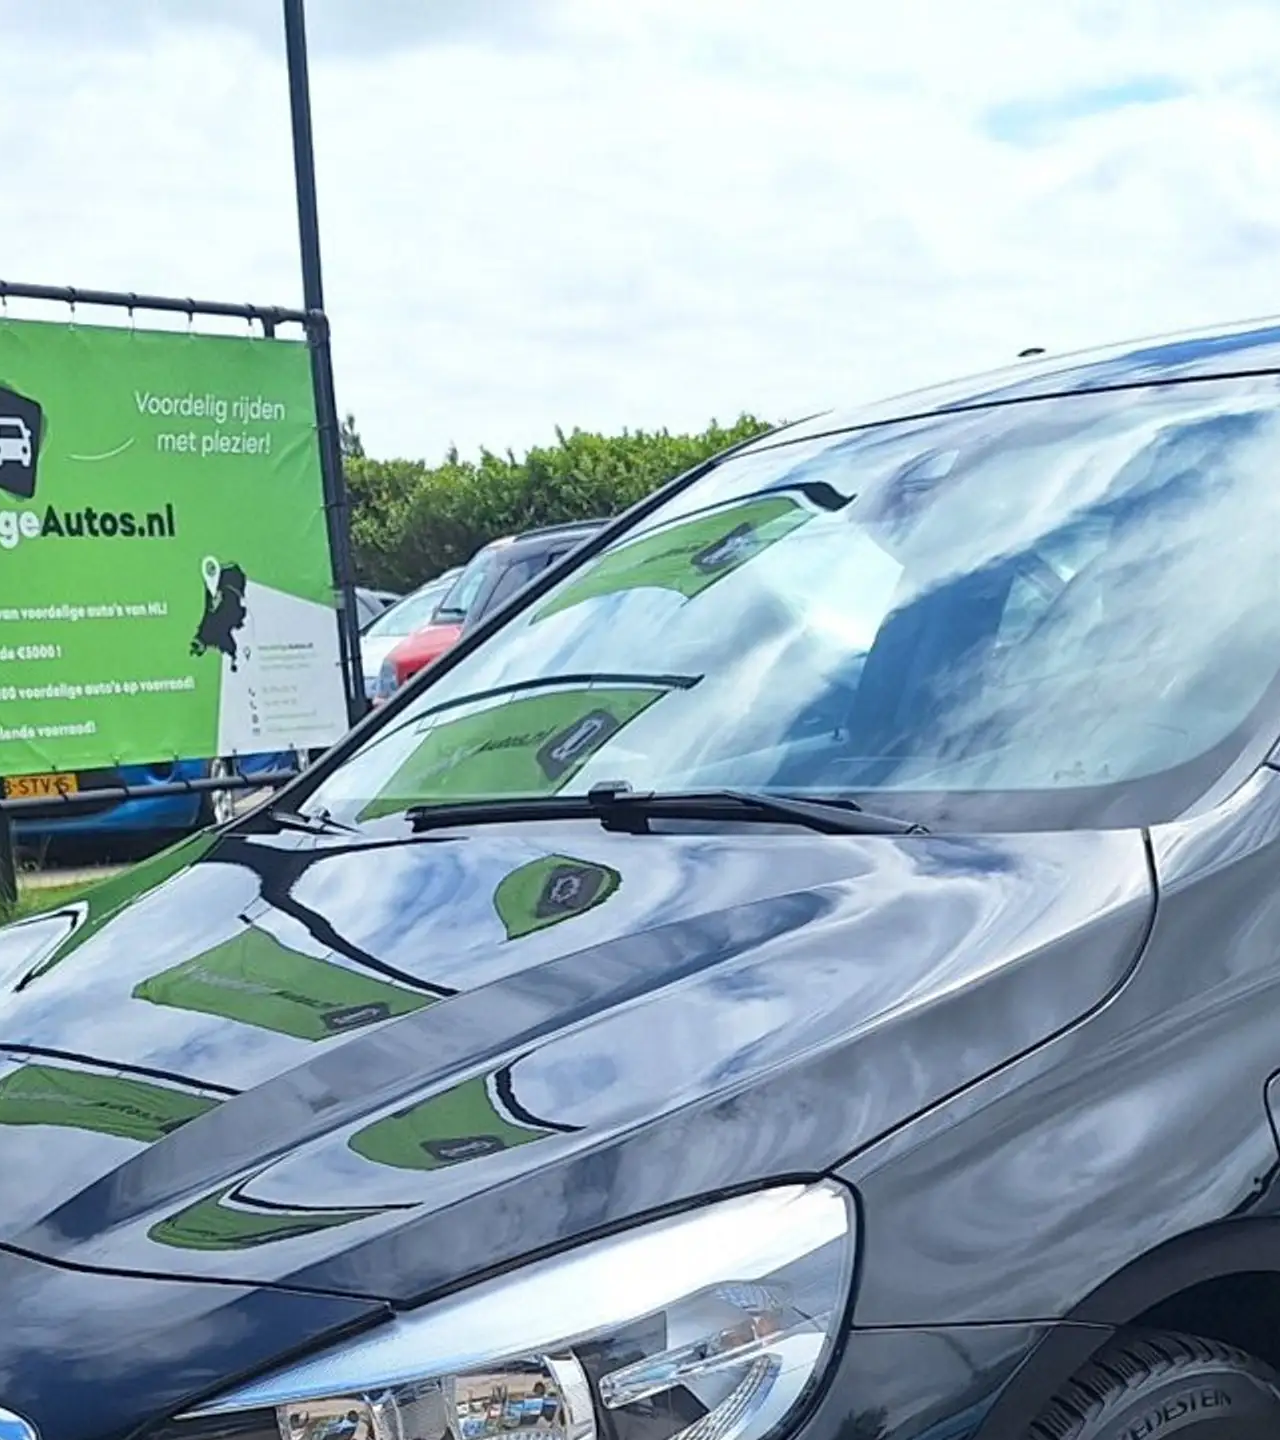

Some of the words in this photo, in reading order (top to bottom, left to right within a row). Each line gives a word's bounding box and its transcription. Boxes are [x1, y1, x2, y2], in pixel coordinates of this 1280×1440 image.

[133, 390, 228, 423] Voordelig
[232, 394, 285, 425] rijden
[157, 431, 197, 451] met
[201, 429, 270, 457] plezier!
[21, 604, 85, 622] voordelige
[86, 601, 124, 617] auto's
[125, 603, 147, 616] van
[18, 682, 83, 700] voordelige
[84, 680, 122, 696] auto's
[123, 680, 139, 696] op
[139, 675, 196, 691] voorraad!
[37, 719, 97, 738] voorraad!
